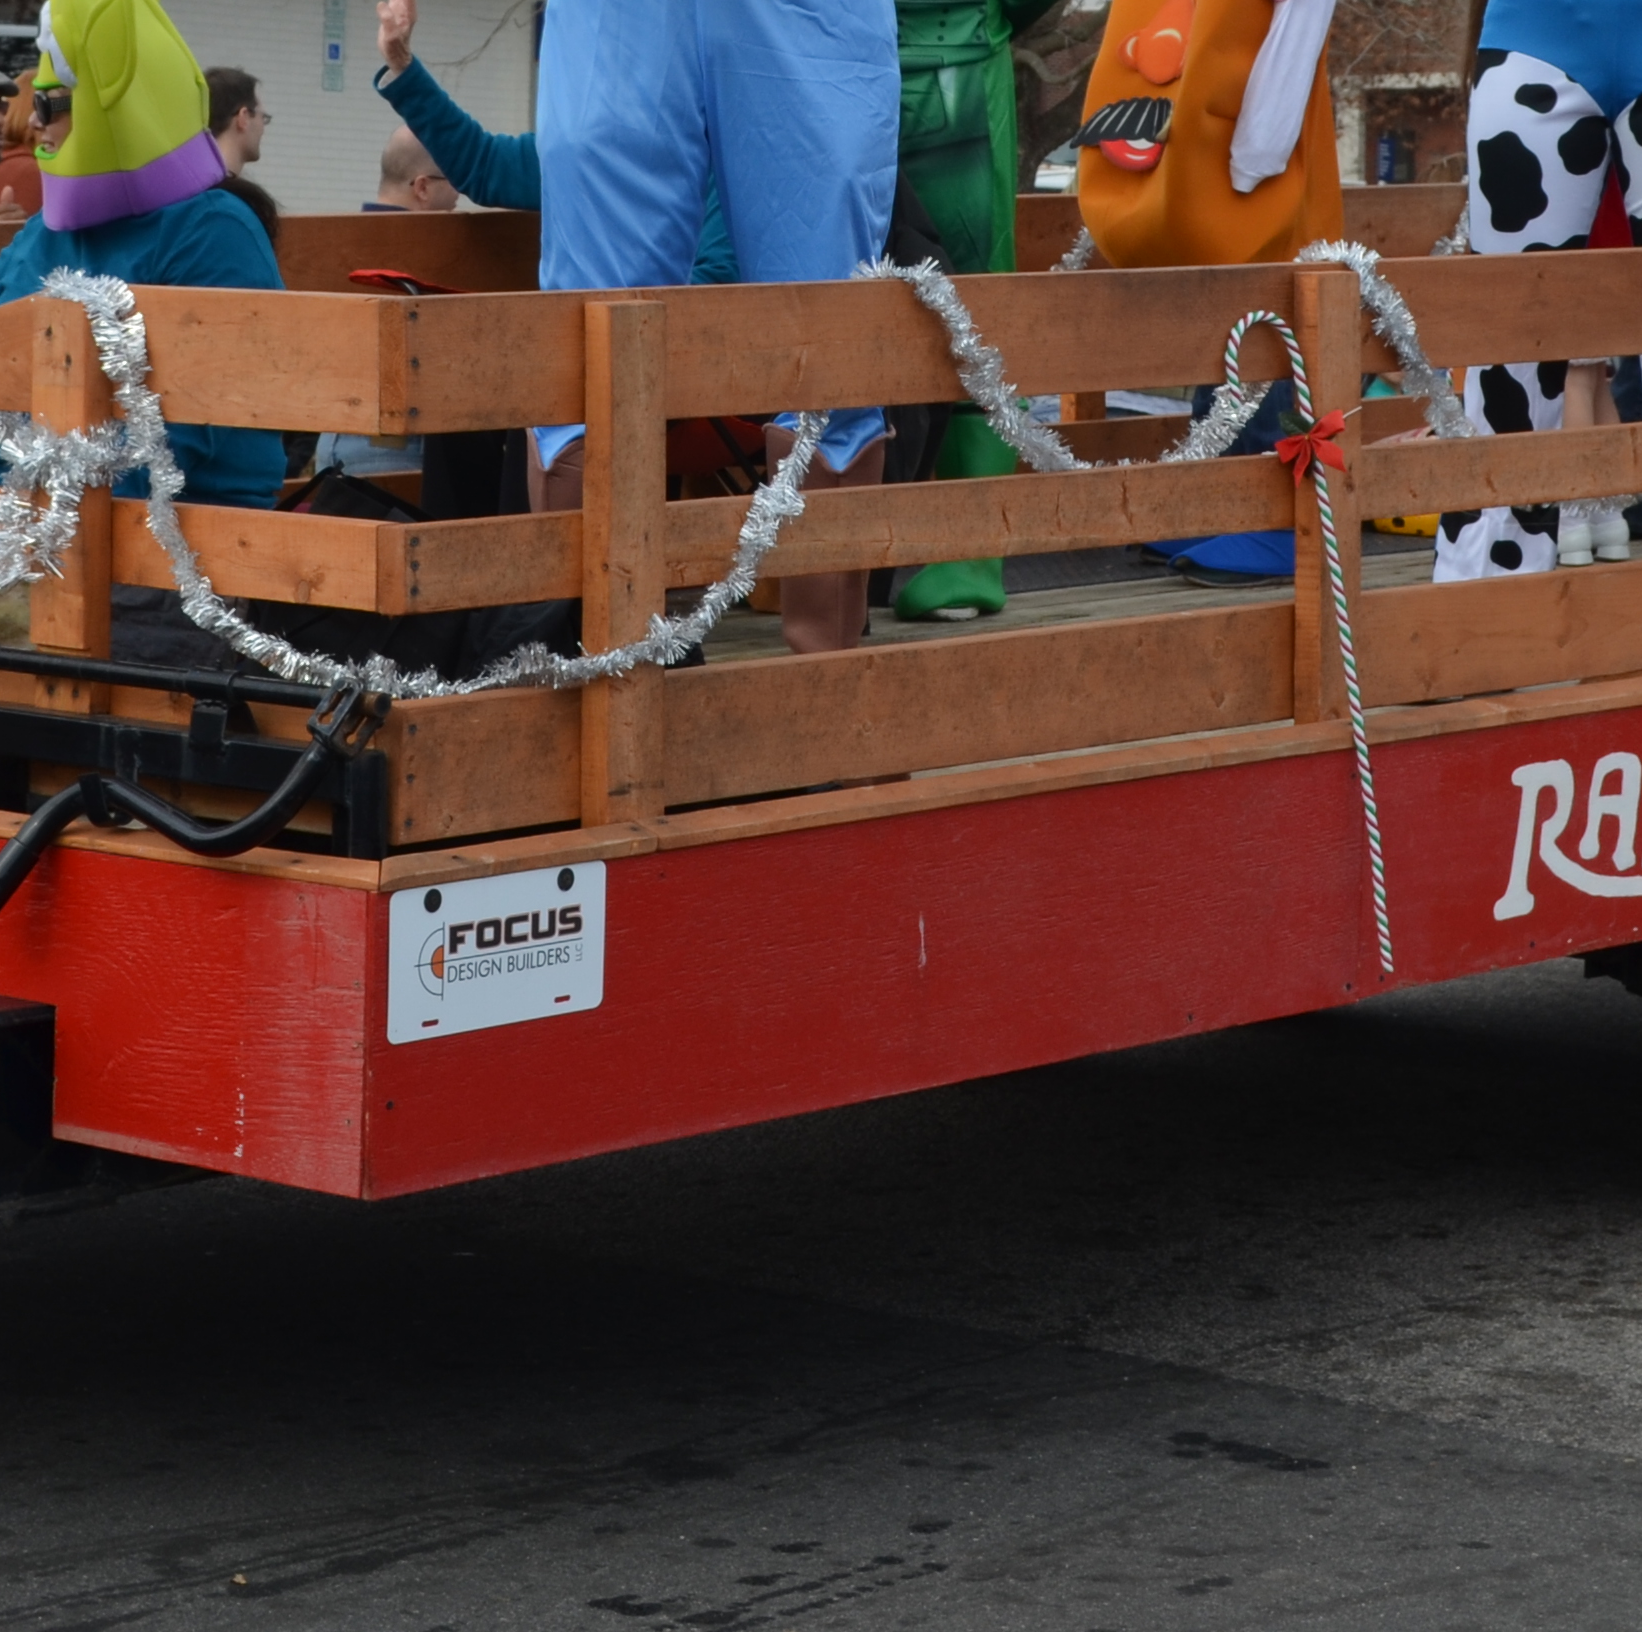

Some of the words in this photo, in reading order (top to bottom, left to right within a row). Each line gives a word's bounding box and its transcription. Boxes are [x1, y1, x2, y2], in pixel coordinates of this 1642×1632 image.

[448, 904, 583, 955] FOCUS
[446, 957, 503, 984] DESIGN
[506, 945, 571, 974] BUILDERS
[574, 942, 584, 962] LLC
